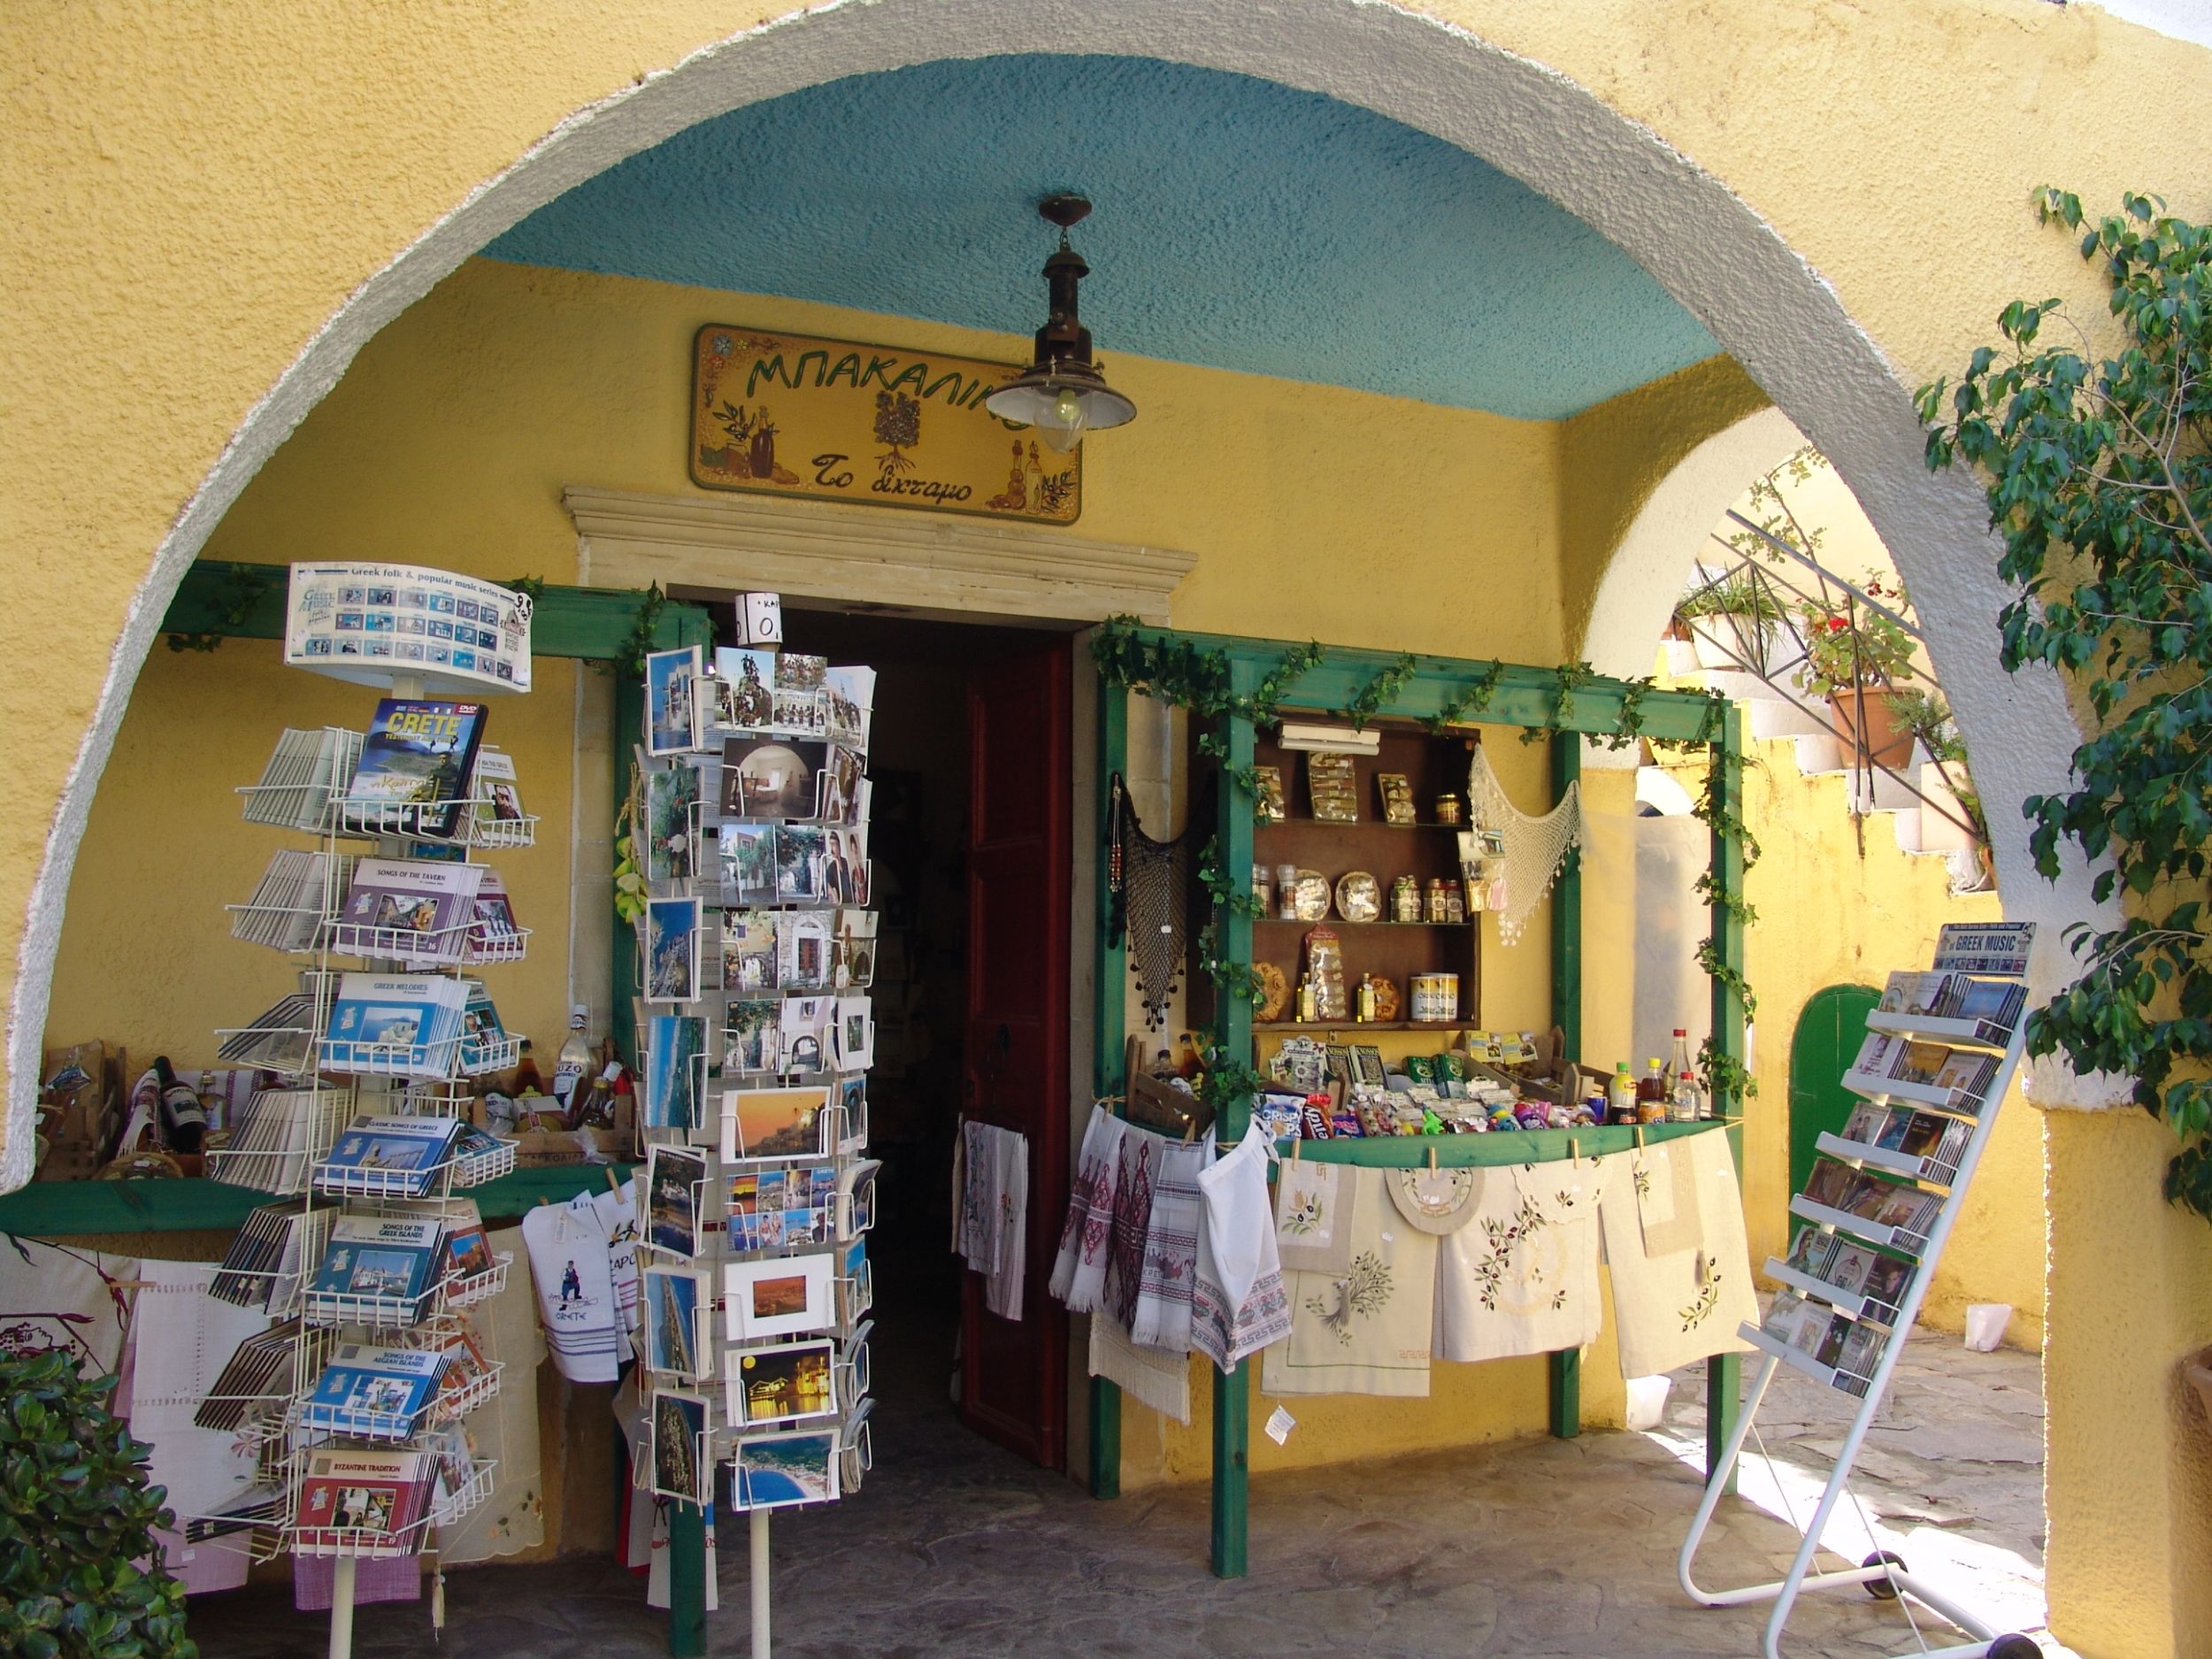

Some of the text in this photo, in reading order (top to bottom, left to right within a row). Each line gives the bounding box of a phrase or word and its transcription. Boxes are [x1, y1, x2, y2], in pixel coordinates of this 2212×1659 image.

[383, 569, 403, 578] folk
[418, 572, 452, 585] popular
[455, 579, 478, 591] music
[479, 586, 499, 598] series
[388, 712, 461, 735] CRETE
[1956, 935, 1984, 951] GREEK
[1985, 935, 2016, 952] MUSIC
[1262, 1109, 1302, 1124] CRISPY
